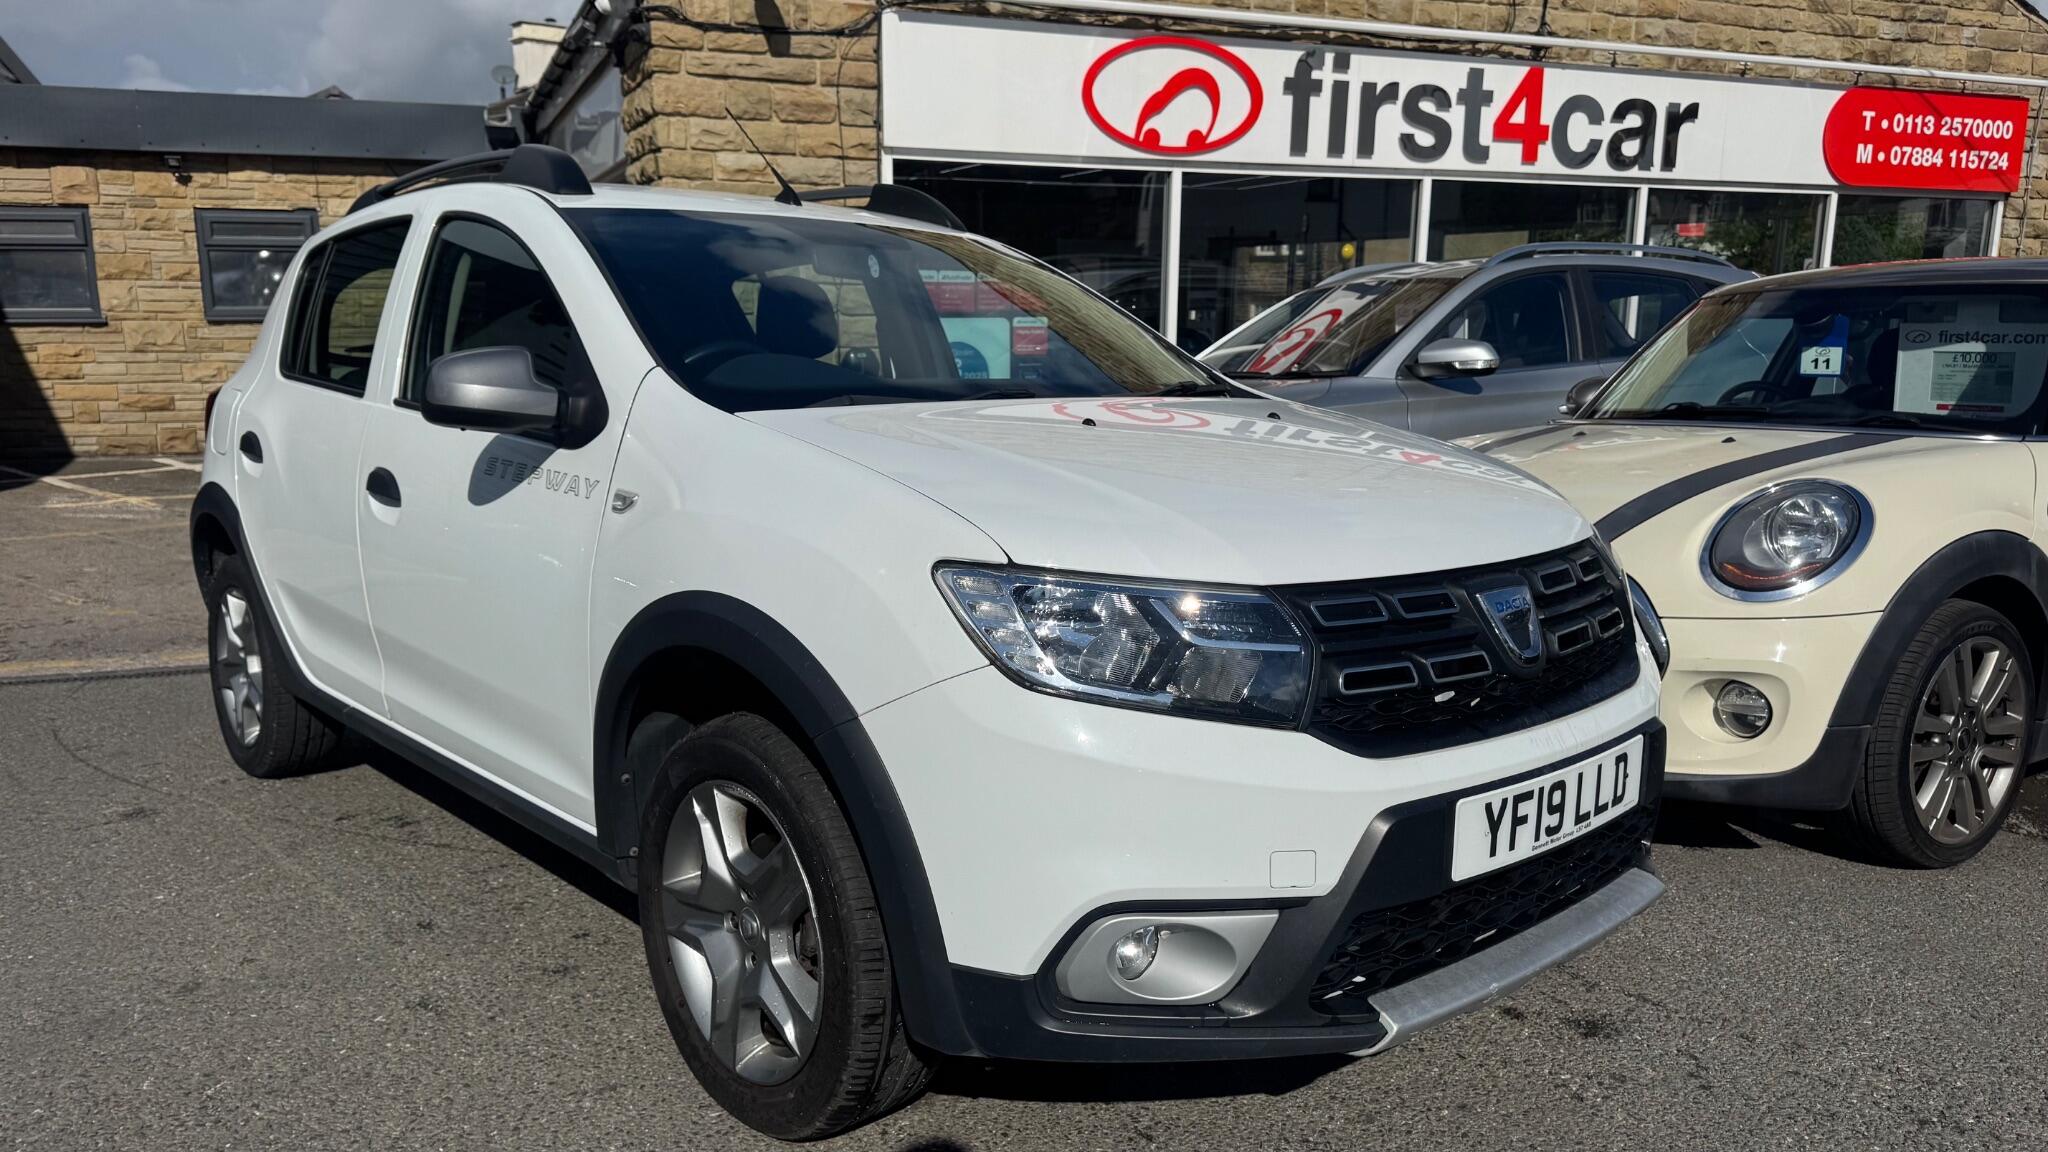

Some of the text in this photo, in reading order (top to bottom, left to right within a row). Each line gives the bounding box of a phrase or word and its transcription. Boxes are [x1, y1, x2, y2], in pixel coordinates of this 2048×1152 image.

[1283, 48, 1699, 172] first4car
[1862, 110, 2013, 139] T 0113 2570000
[1856, 143, 2009, 170] M 07884 115724
[1810, 357, 1831, 370] 11
[484, 456, 600, 499] STEPWAY
[1495, 596, 1531, 614] DACIA
[1484, 752, 1629, 858] YF19 LLD
